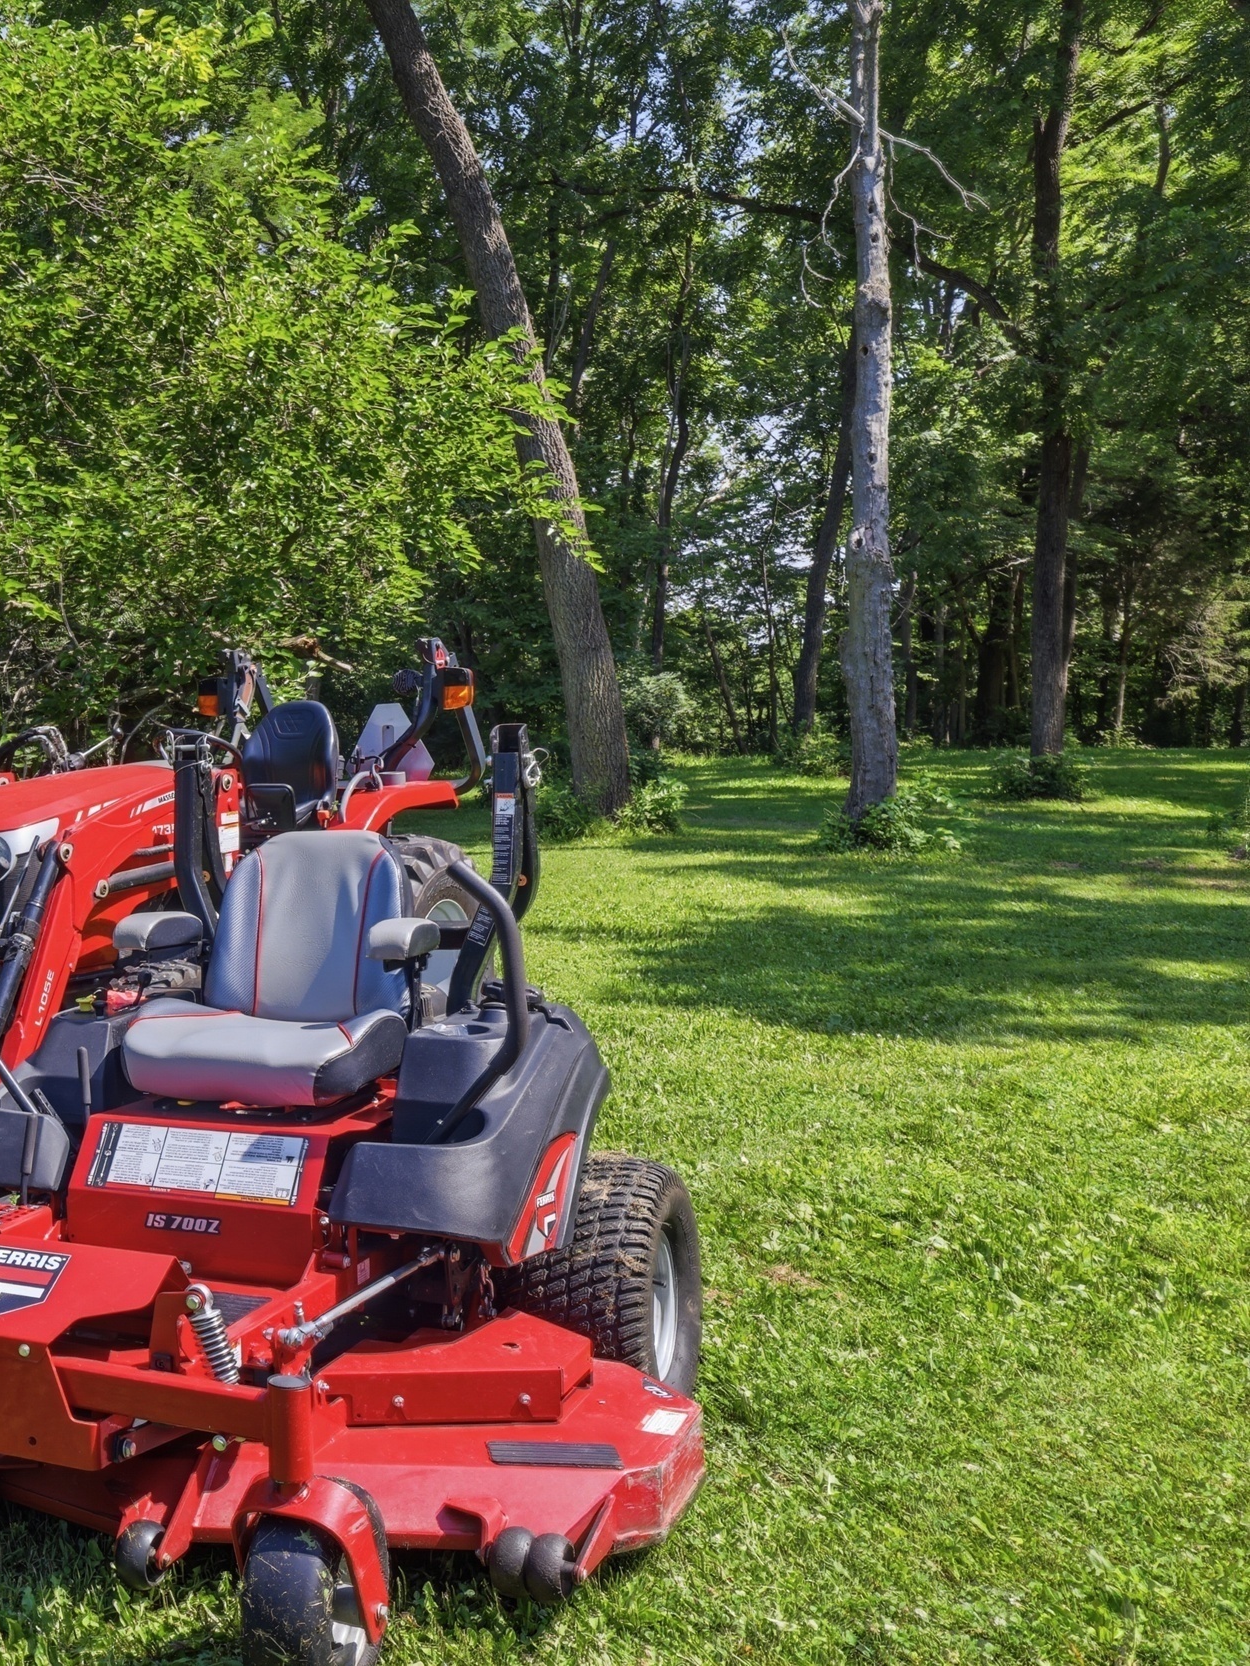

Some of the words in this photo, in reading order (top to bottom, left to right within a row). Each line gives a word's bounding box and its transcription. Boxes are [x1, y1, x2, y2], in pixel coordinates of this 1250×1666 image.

[158, 792, 176, 803] MASSE
[146, 1213, 167, 1228] IS
[170, 1215, 220, 1234] 700Z
